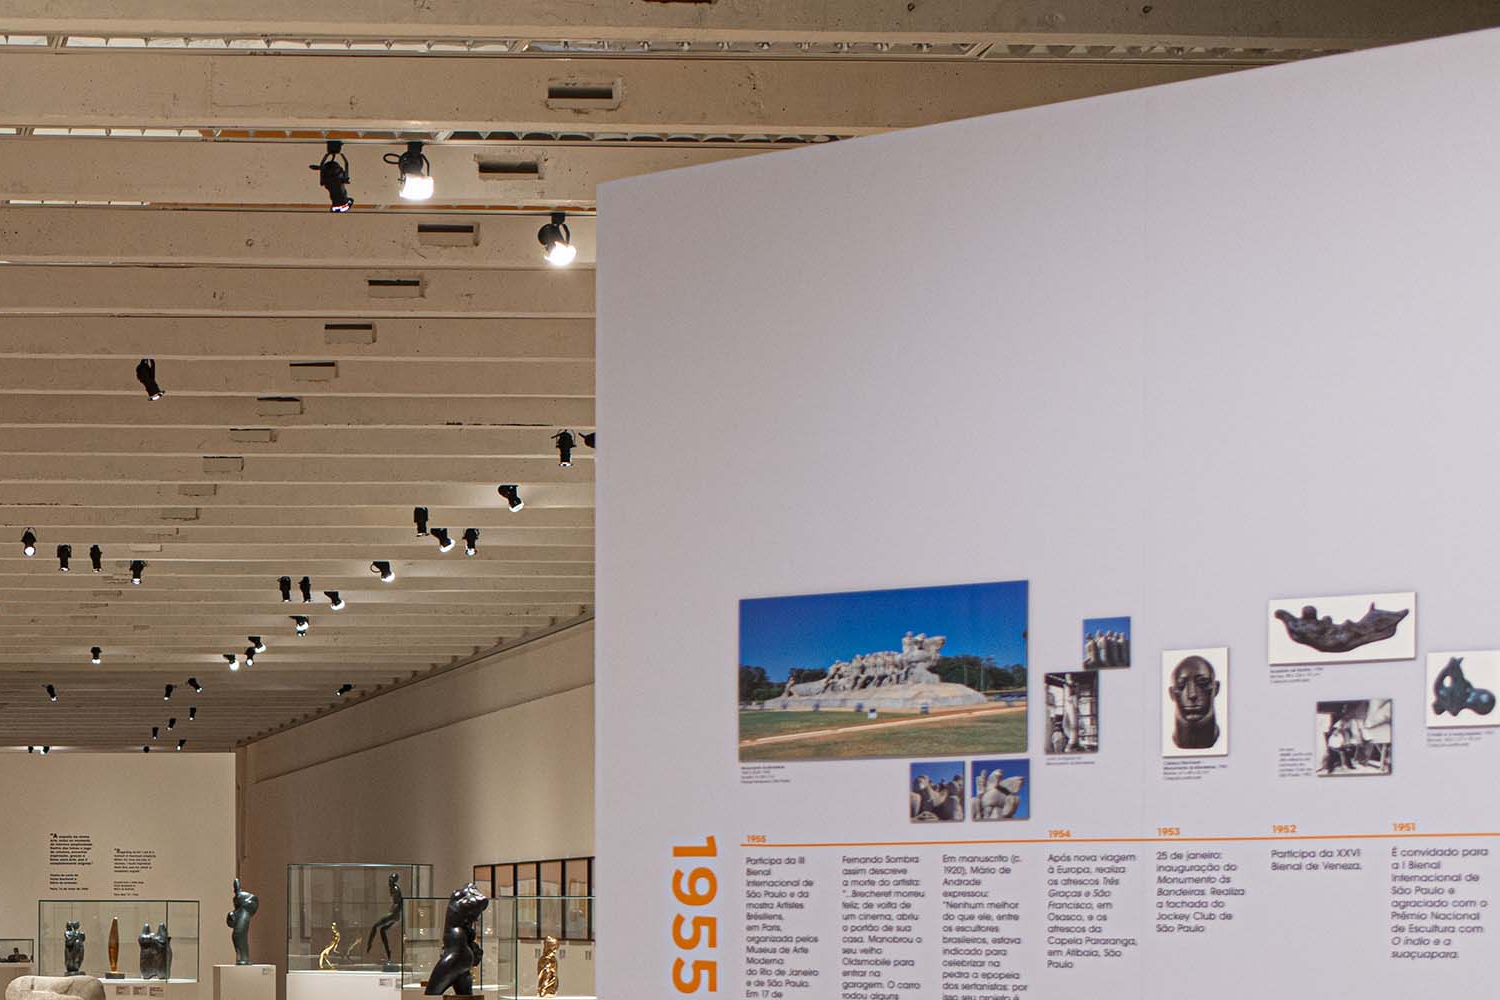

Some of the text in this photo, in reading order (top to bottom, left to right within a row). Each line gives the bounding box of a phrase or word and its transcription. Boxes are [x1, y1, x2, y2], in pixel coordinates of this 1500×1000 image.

[1157, 827, 1180, 836] 1953
[1271, 824, 1297, 833] 1952
[1393, 823, 1416, 831] 1951
[746, 834, 767, 843] 1955
[1048, 830, 1071, 838] 1954
[1156, 851, 1167, 860] 25
[1271, 848, 1360, 859] Participa da XXVI
[1400, 848, 1458, 856] convidado
[1462, 848, 1488, 857] para
[1047, 853, 1071, 862] Após
[1100, 854, 1135, 863] viagem
[1095, 865, 1126, 873] realiza
[1156, 863, 1220, 874] inauguração
[1271, 862, 1302, 870] Bienal
[1408, 860, 1440, 869] Bienal
[1156, 875, 1216, 884] Monumento
[1391, 873, 1479, 882] Internacional de
[1210, 887, 1245, 895] Realiza
[1391, 885, 1411, 895] São
[1414, 885, 1444, 894] Paulo
[1165, 900, 1208, 908] fachada
[1210, 900, 1225, 908] do
[1391, 899, 1448, 910] agraciado
[672, 835, 718, 994] 1955
[1156, 912, 1190, 921] Jockey
[1193, 911, 1216, 920] Club
[1391, 911, 1480, 920] Prêmio Nacional
[1391, 924, 1405, 932] de
[1408, 923, 1455, 933] Escultura
[1403, 936, 1430, 945] índio
